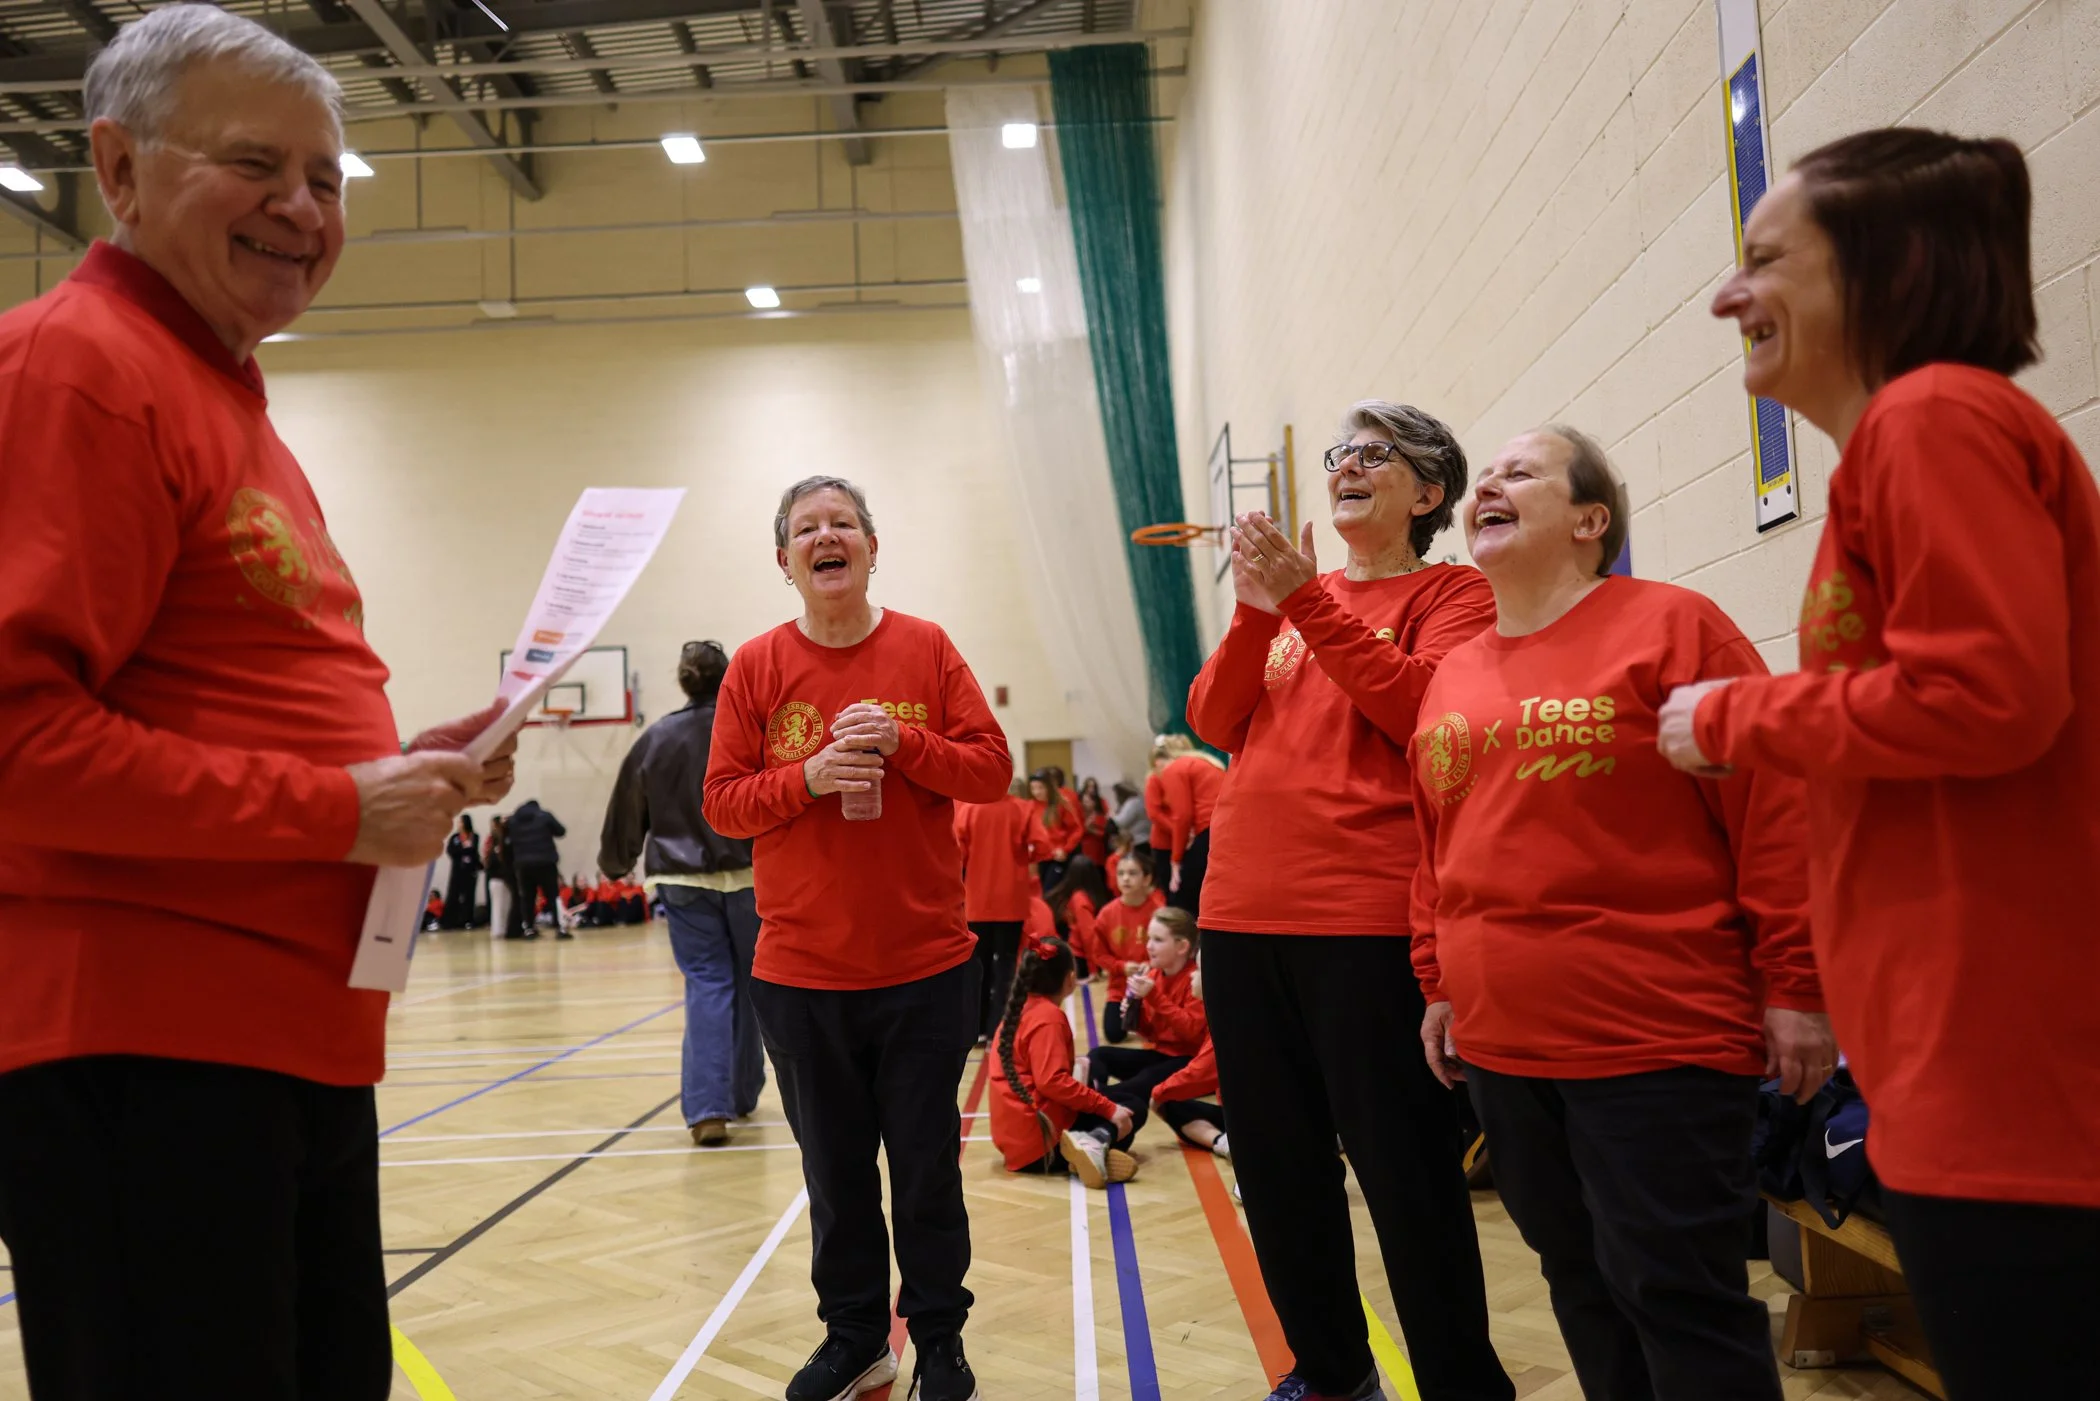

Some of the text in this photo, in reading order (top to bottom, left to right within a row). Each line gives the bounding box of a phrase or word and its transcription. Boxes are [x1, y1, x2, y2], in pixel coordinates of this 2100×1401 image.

[771, 703, 820, 730] MIDDLESBROUGH
[1520, 696, 1616, 725] Tees
[803, 734, 820, 753] CLUB
[1516, 723, 1616, 750] Dance
